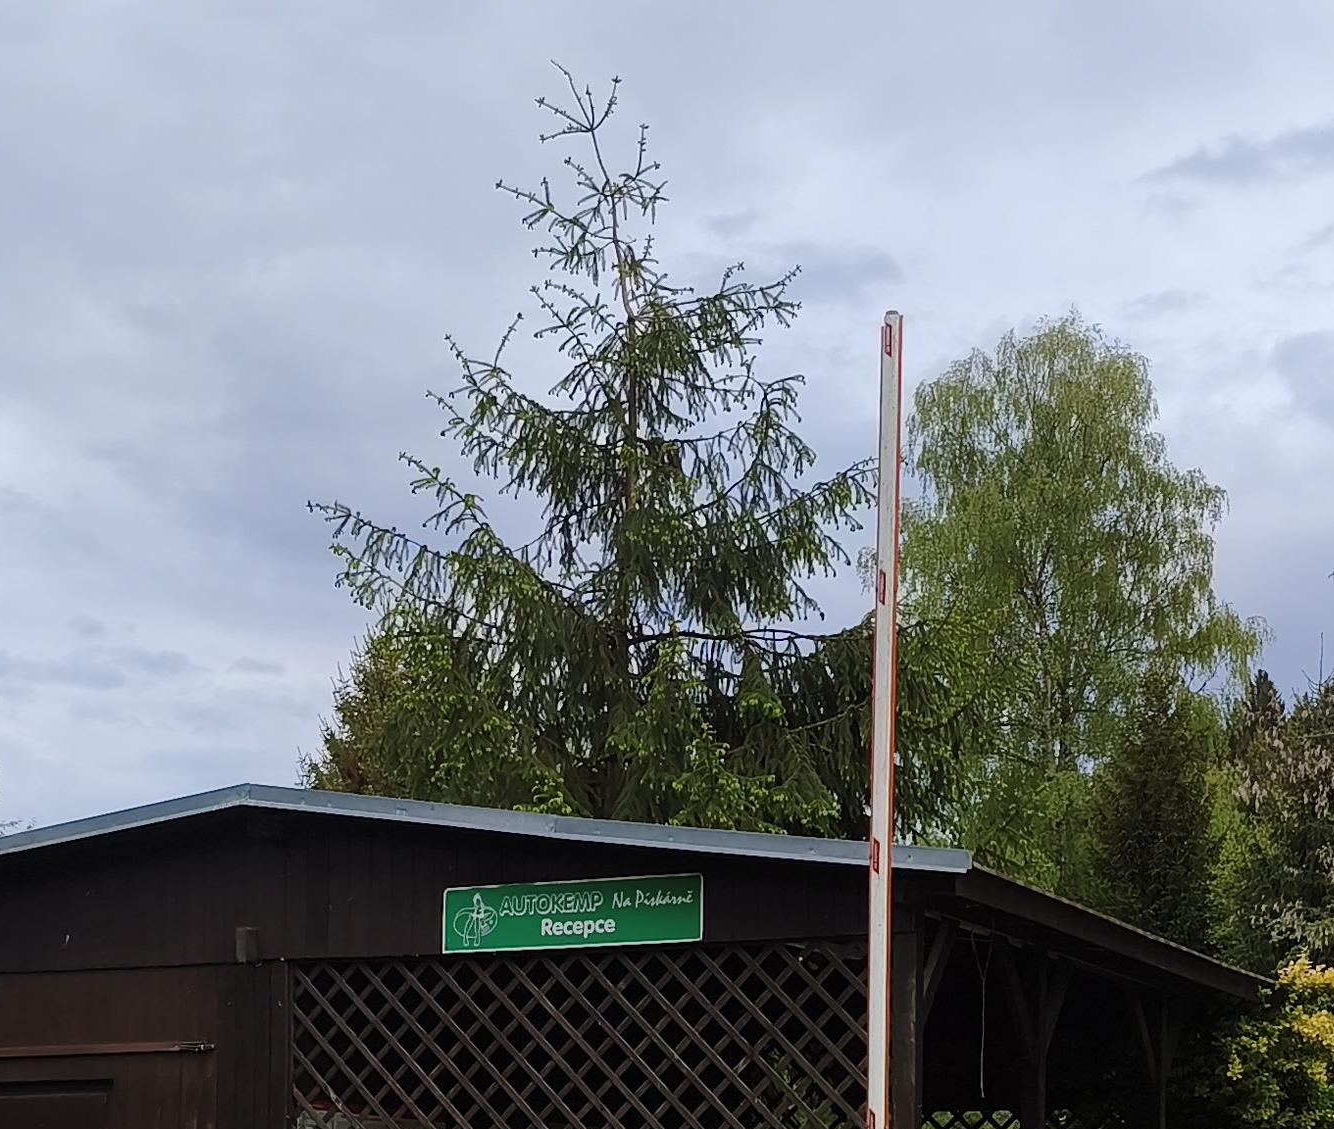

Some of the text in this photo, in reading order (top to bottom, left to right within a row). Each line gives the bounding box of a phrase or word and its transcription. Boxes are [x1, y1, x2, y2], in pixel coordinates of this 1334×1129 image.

[499, 891, 603, 916] AUTOKEMP
[612, 891, 632, 909] Na
[541, 918, 616, 938] Recepce
